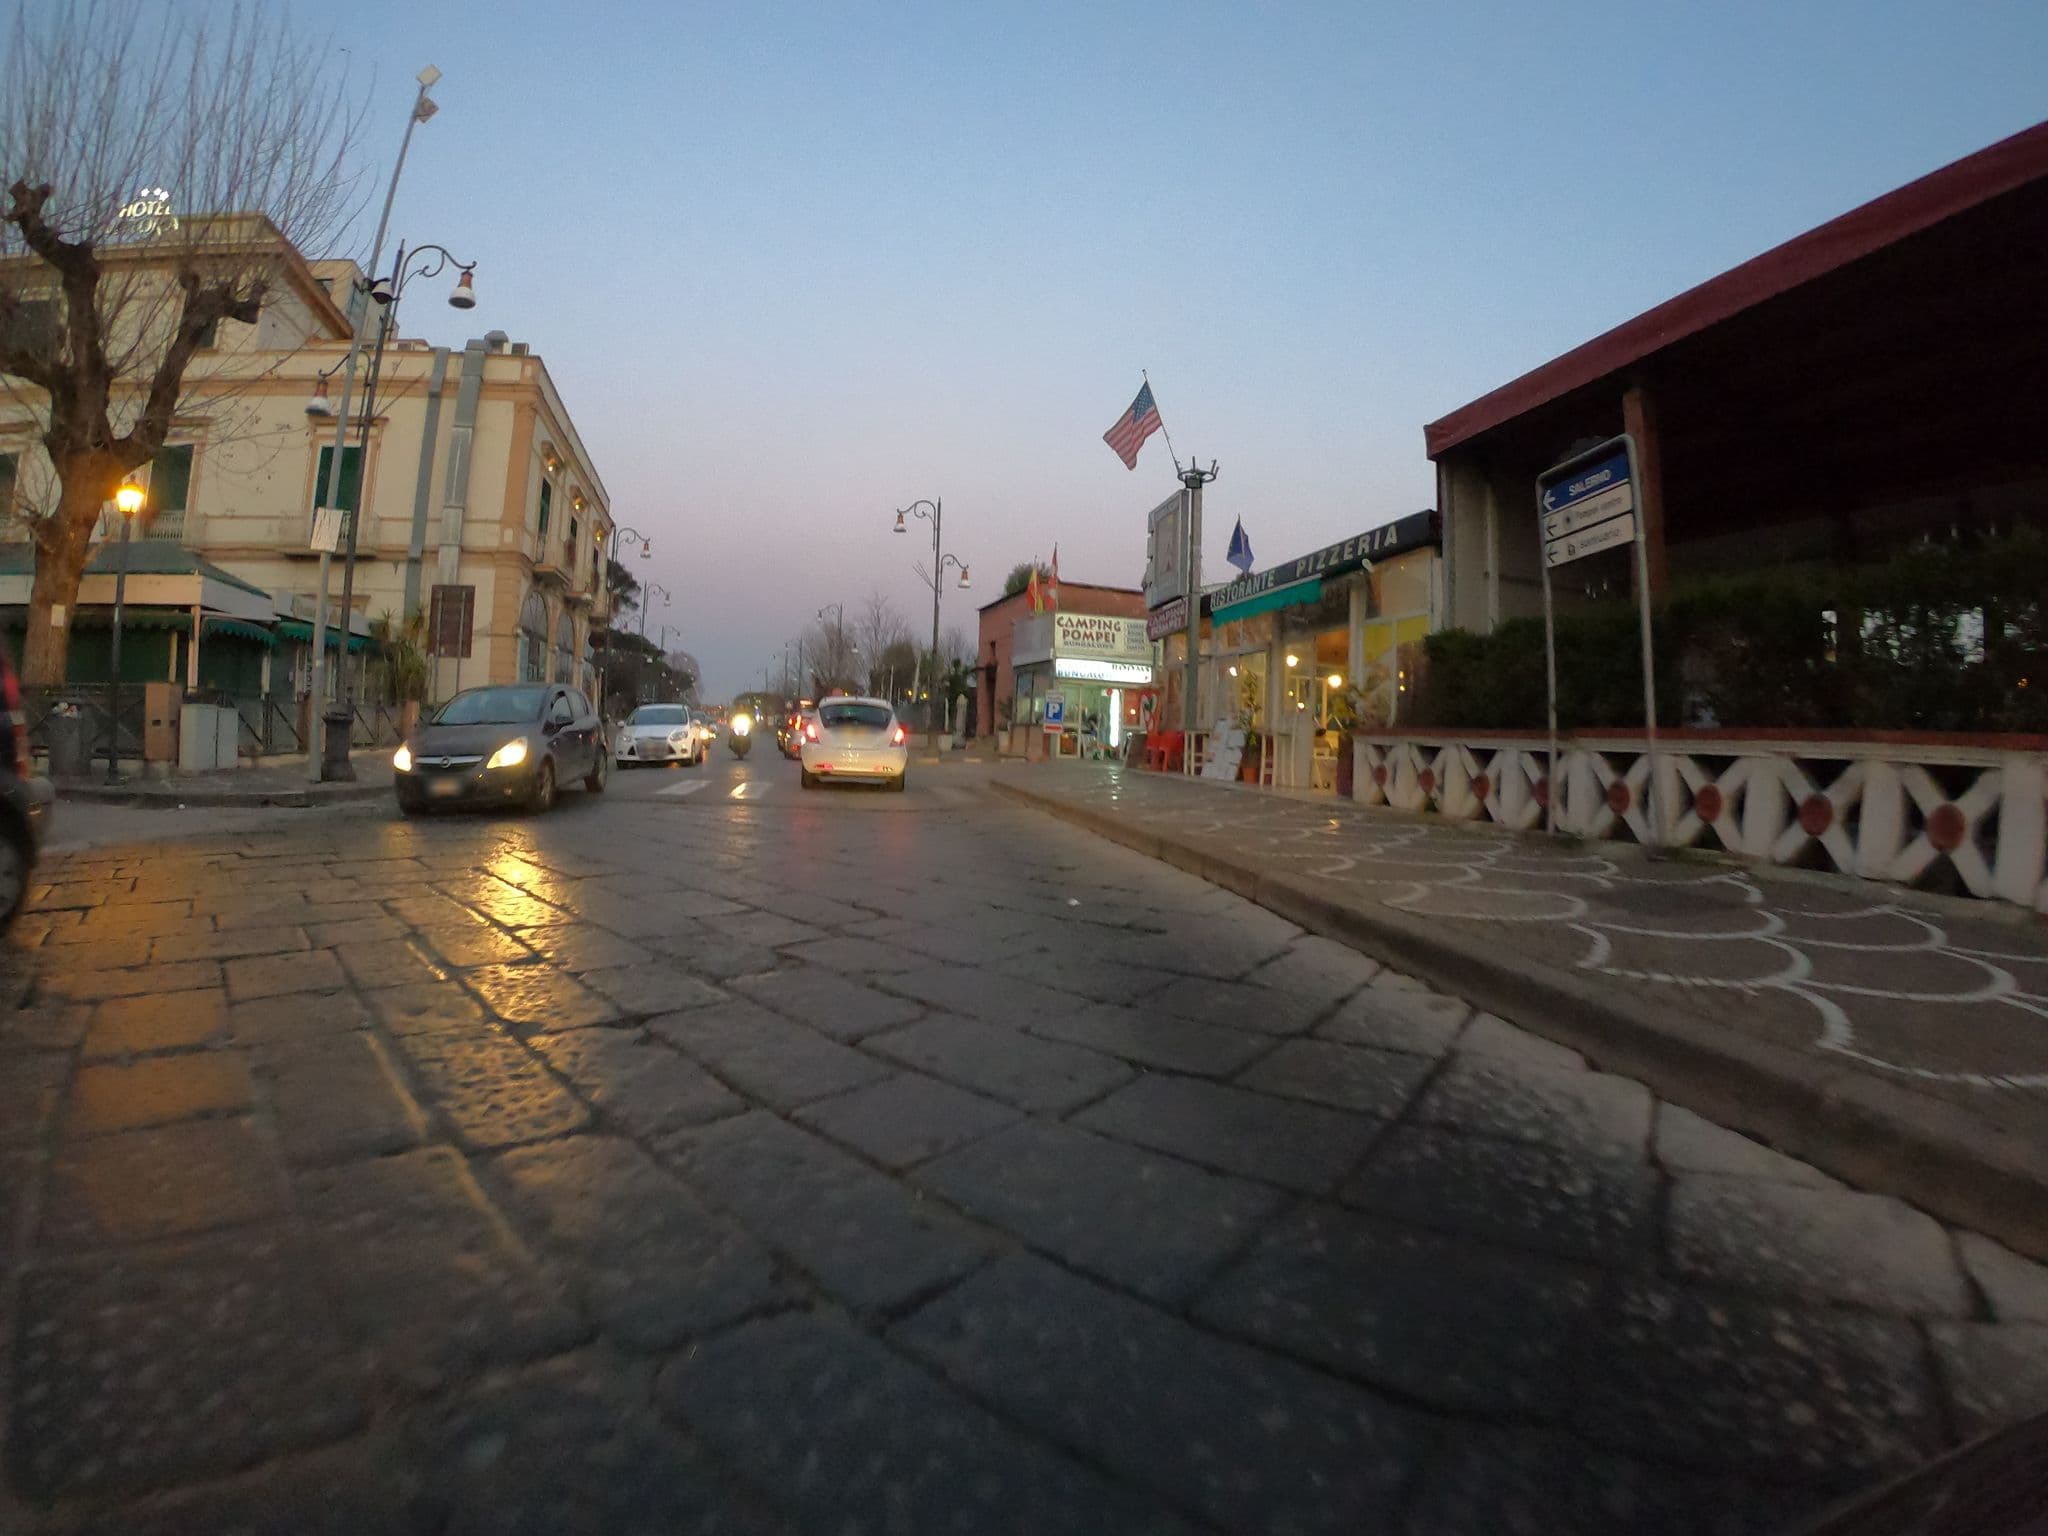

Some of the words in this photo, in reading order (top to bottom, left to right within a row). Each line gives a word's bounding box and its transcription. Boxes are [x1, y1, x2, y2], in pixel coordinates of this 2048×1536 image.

[119, 201, 171, 217] HOTEL
[1209, 569, 1275, 608] RISTORANTE
[1296, 524, 1398, 577] PIZZERIA
[1057, 616, 1121, 632] CAMPING
[1062, 629, 1116, 643] POMPEI
[1057, 669, 1113, 679] BUNGALO
